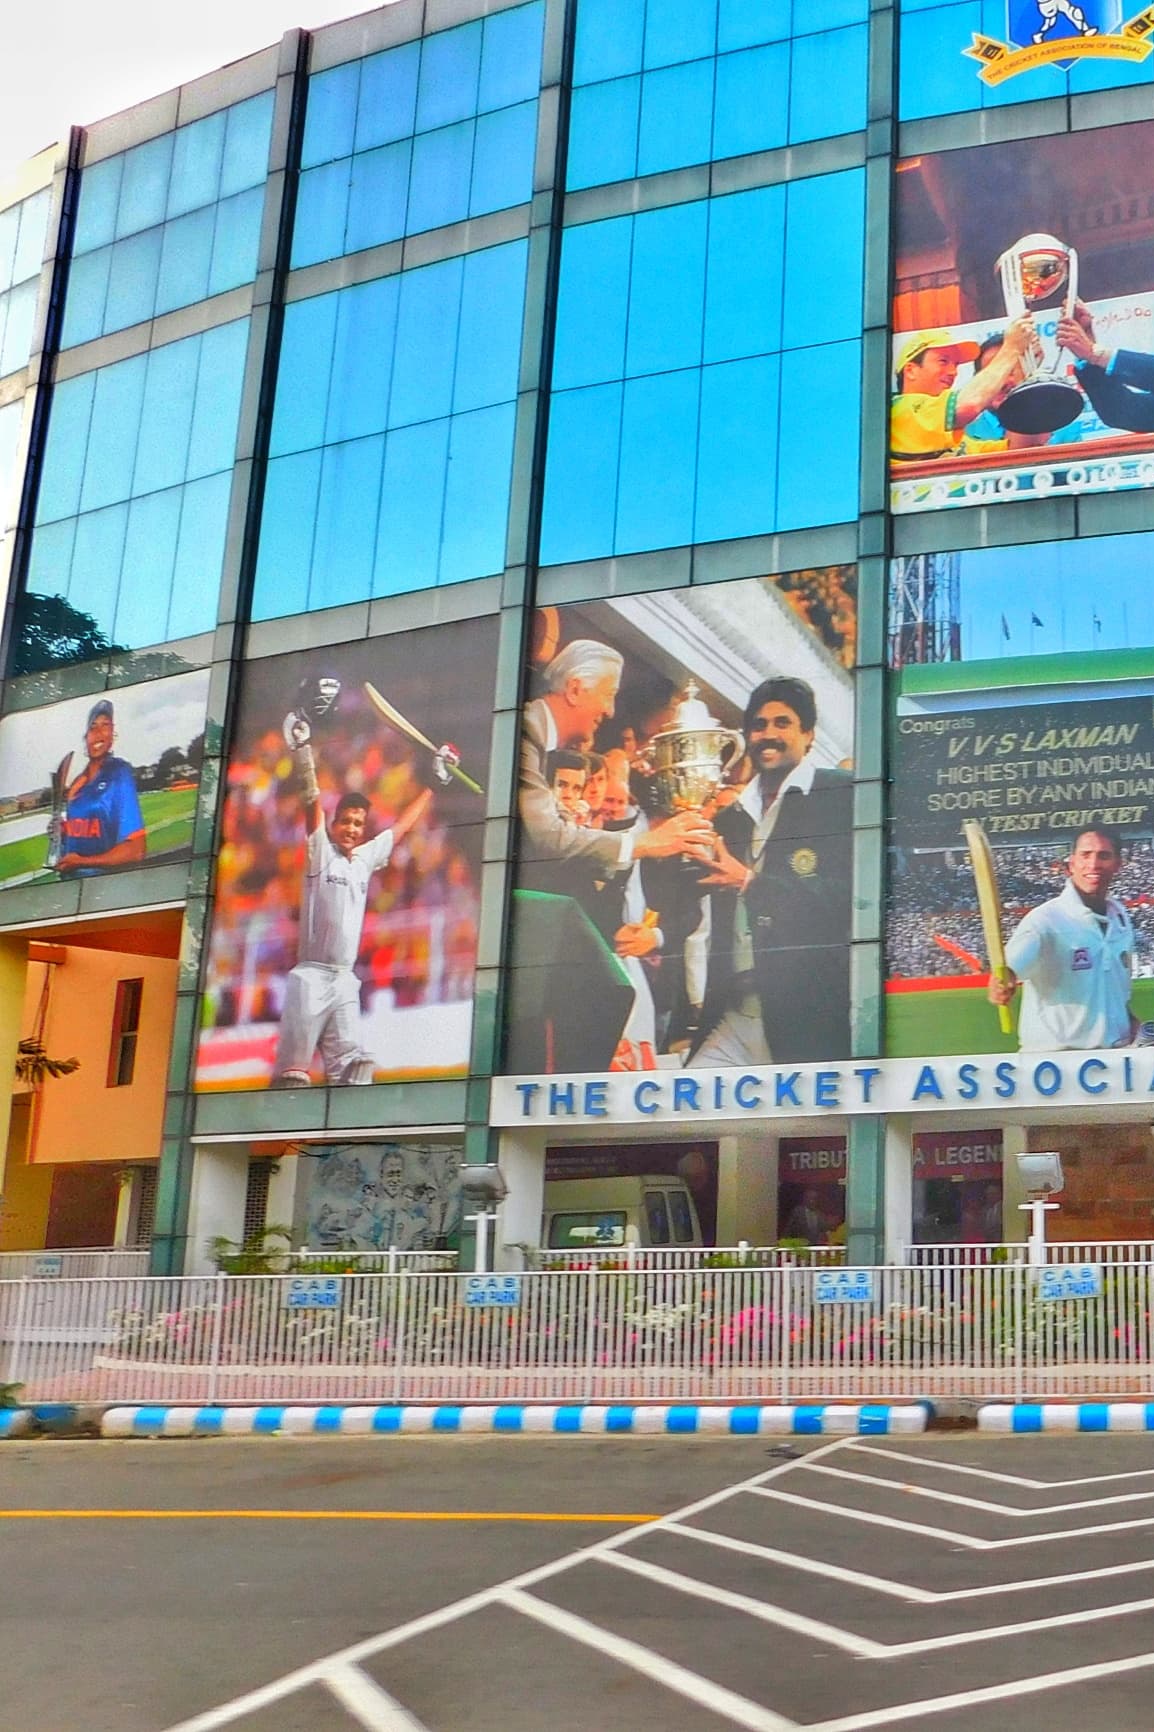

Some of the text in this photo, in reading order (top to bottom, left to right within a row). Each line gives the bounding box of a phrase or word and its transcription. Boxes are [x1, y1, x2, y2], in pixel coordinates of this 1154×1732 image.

[1040, 42, 1095, 56] ASSOCIATION
[1109, 43, 1143, 55] BENGAL
[900, 715, 976, 736] Congrats
[1020, 723, 1140, 753] LAXMAN
[936, 761, 1034, 787] HIGHEST
[927, 788, 1002, 812] SCORE
[1006, 785, 1038, 806] BY
[1039, 780, 1088, 804] ANY
[988, 812, 1046, 833] TEST
[515, 1080, 609, 1117] THE
[633, 1066, 882, 1114] CRICKET
